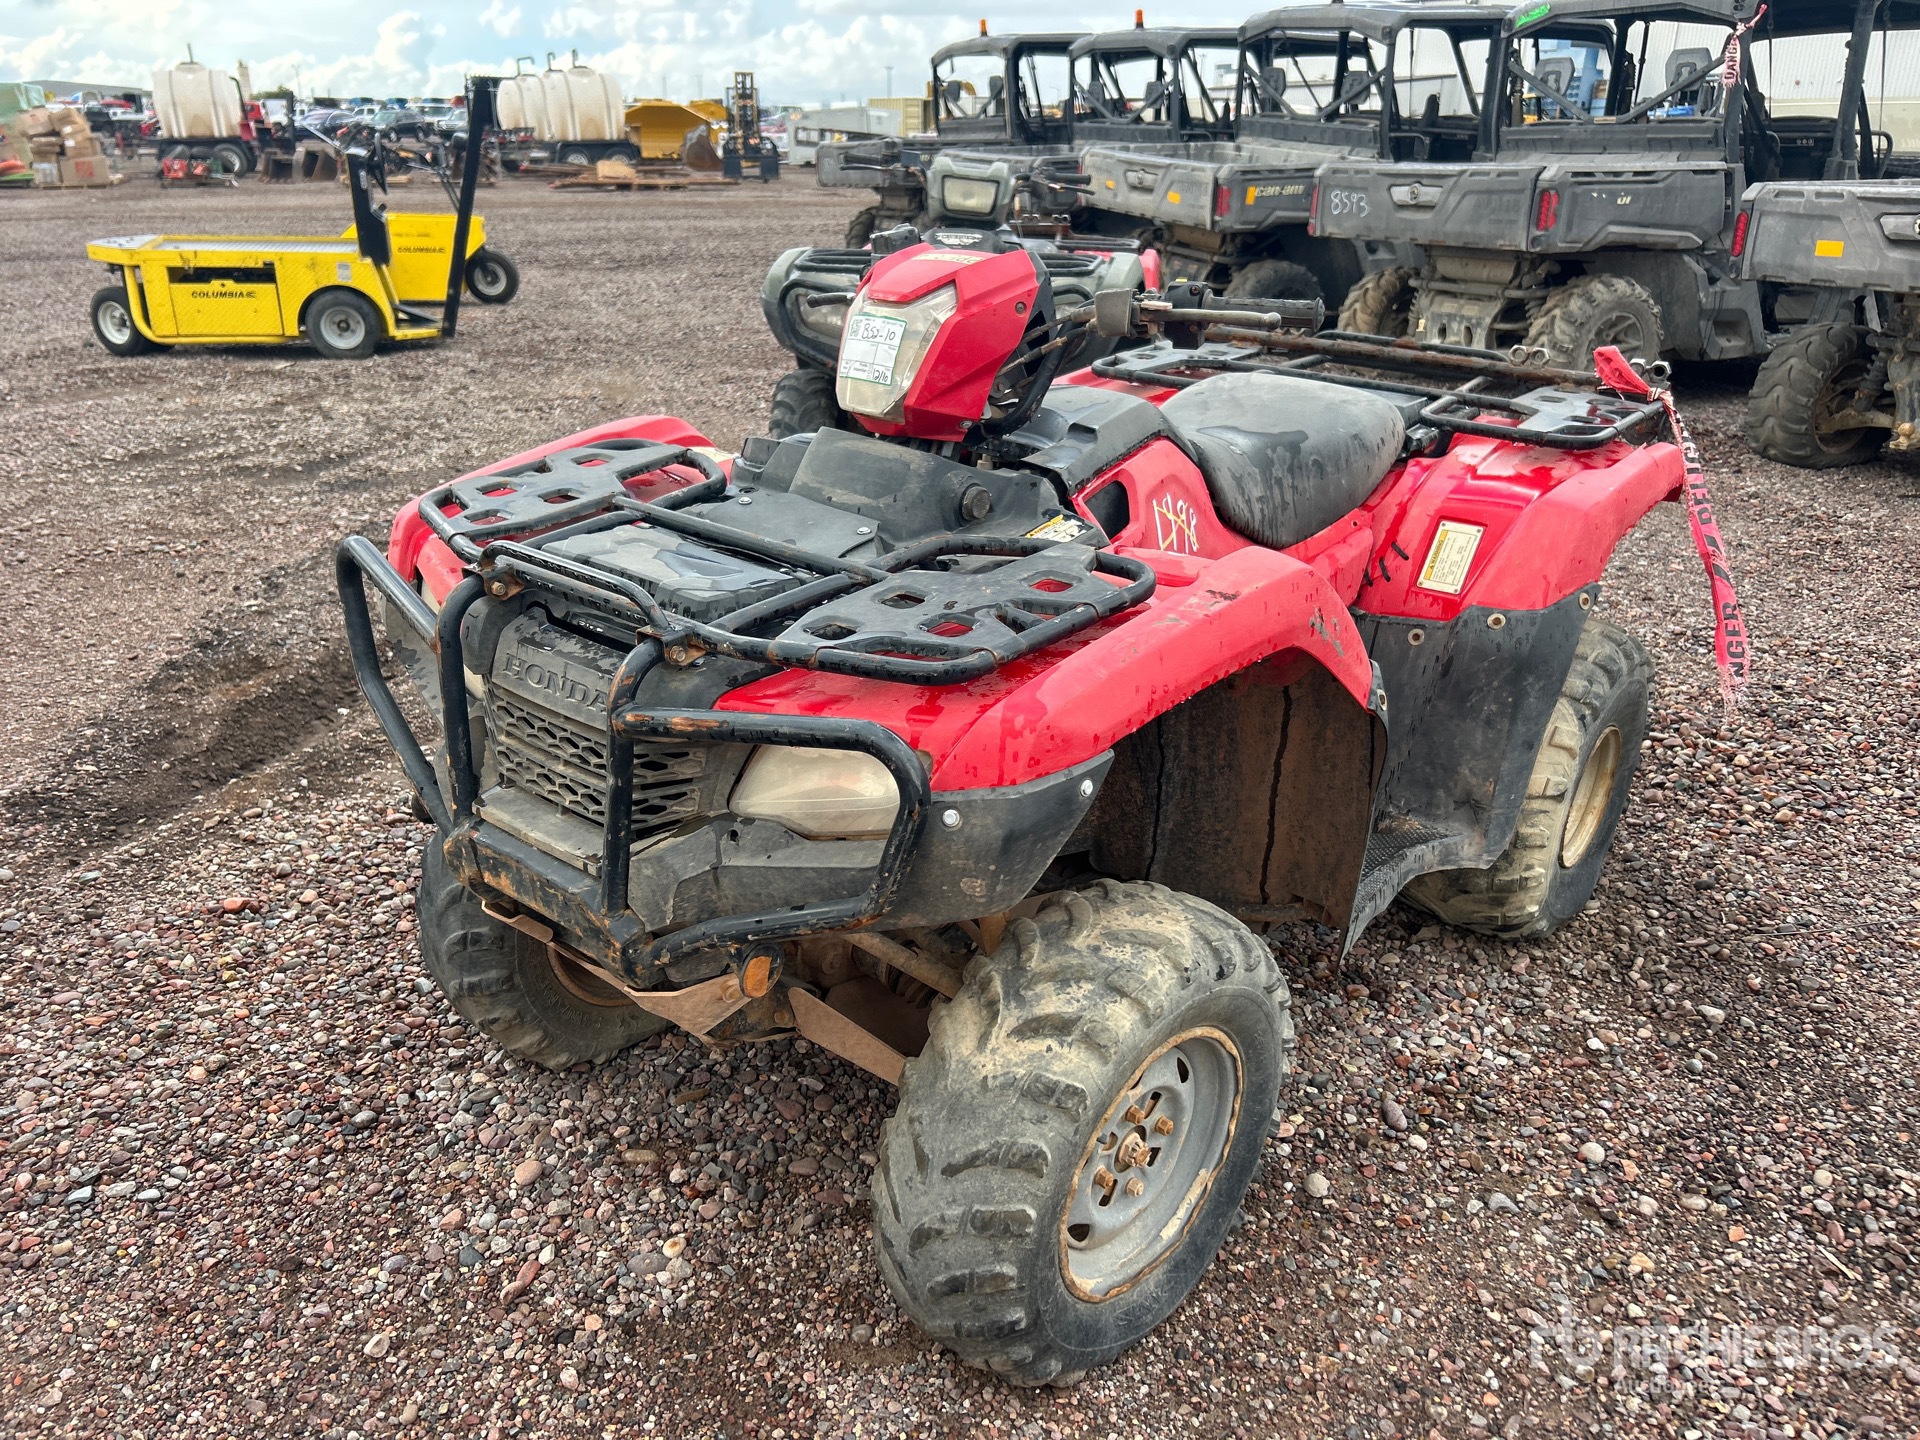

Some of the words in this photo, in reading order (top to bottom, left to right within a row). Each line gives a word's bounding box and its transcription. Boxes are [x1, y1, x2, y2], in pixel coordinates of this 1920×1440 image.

[1330, 189, 1371, 218] 8593
[191, 290, 245, 299] COLUMBIA
[1679, 427, 1713, 525] PELIG
[1721, 601, 1746, 682] NGER
[502, 652, 608, 715] HONDA
